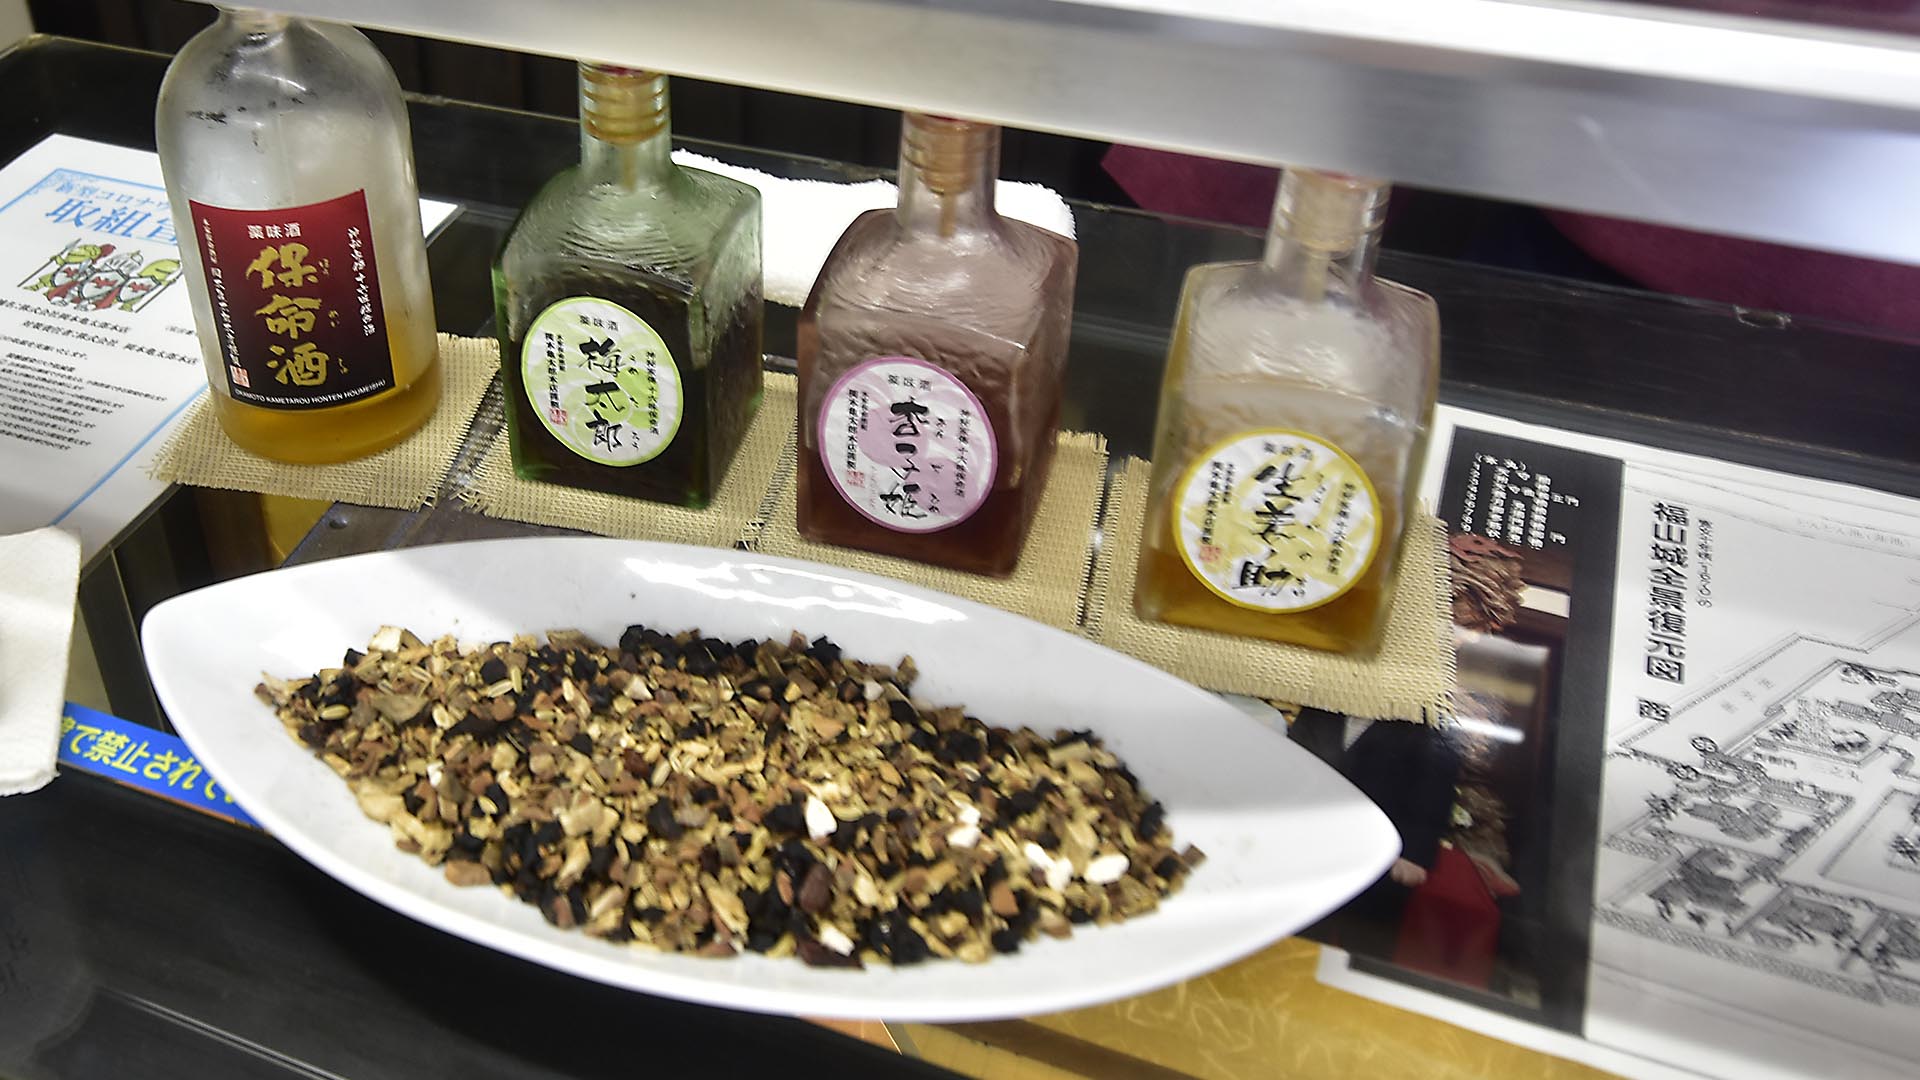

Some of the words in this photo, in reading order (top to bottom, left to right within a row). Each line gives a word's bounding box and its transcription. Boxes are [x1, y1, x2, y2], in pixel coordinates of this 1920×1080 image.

[247, 222, 301, 239] 薬味酒
[245, 243, 329, 387] 保命酒
[311, 392, 343, 404] HONTEN
[61, 717, 235, 803] で禁止され
